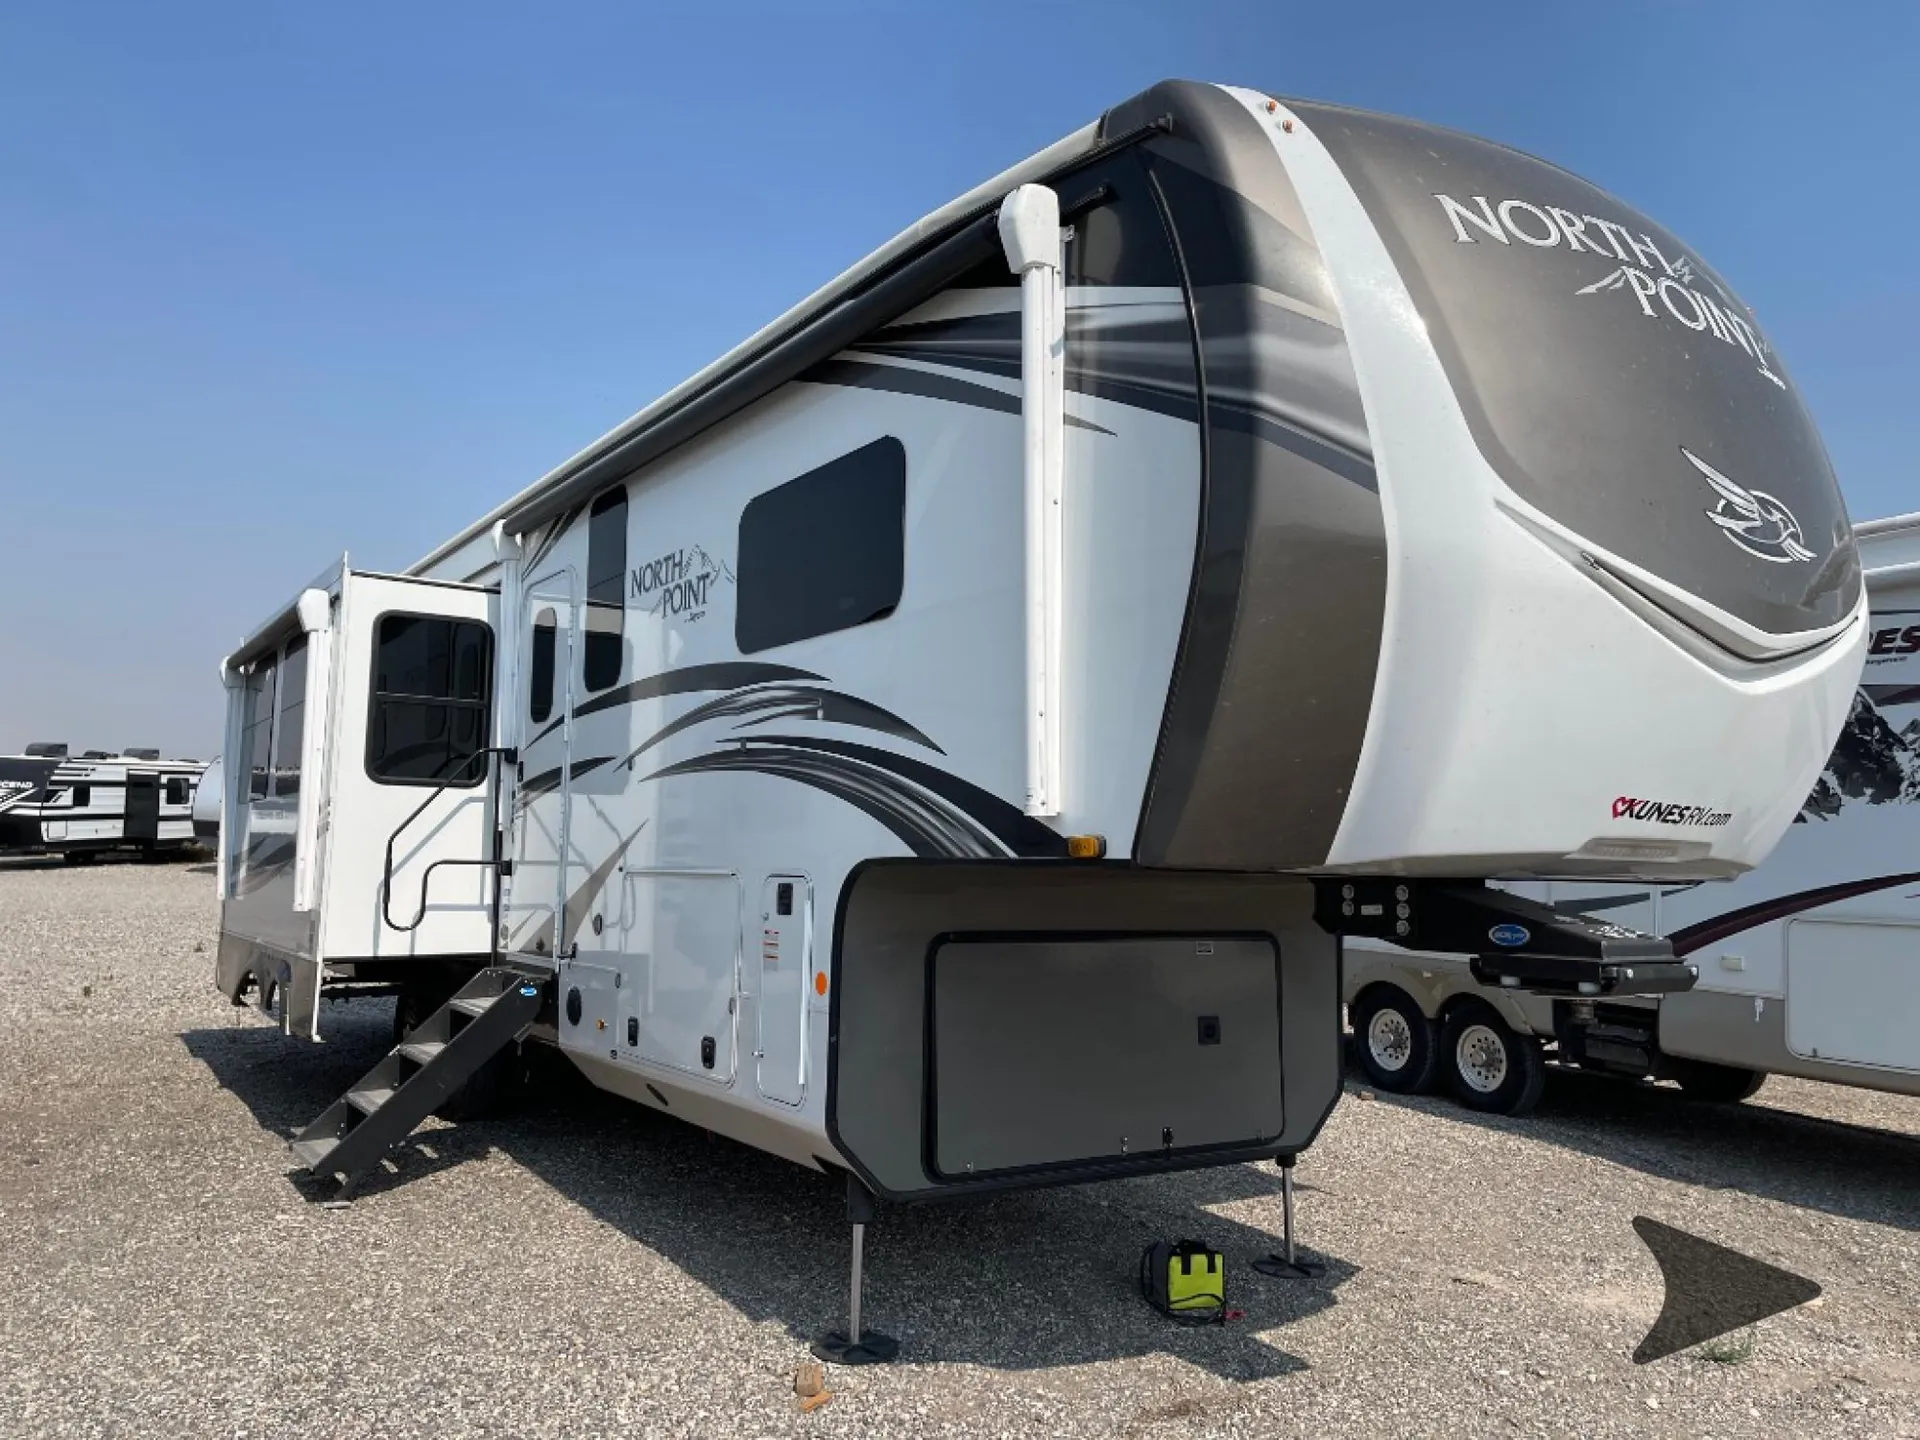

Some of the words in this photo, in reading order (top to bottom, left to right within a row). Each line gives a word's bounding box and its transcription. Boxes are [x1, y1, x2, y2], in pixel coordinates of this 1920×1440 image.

[1431, 194, 1677, 278] NORTH
[1620, 265, 1781, 385] POINT
[630, 549, 684, 598] NORTH
[661, 571, 711, 619] POINT
[1868, 624, 1920, 655] ES
